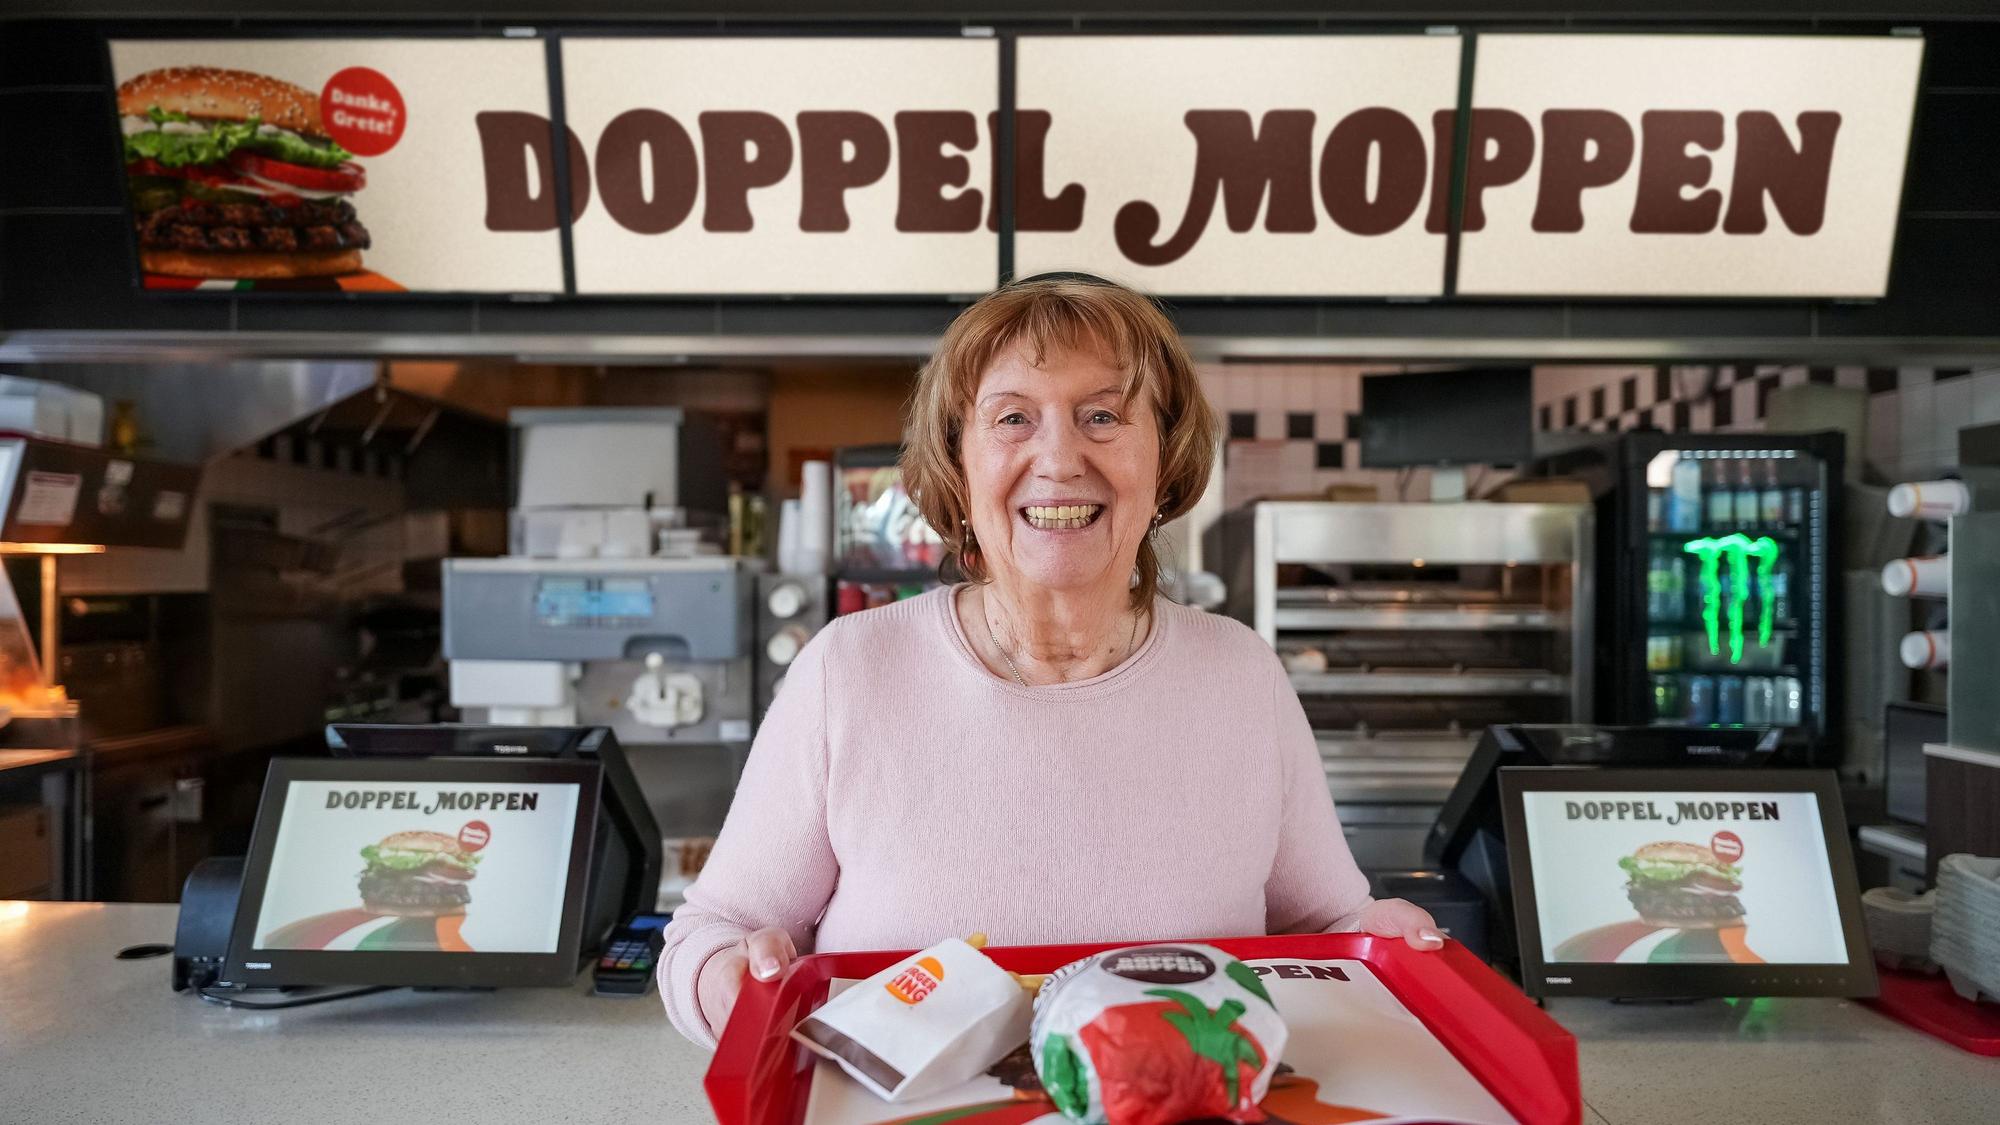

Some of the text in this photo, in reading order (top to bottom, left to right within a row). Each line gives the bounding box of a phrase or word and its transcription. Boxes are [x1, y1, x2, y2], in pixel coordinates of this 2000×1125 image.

[331, 88, 397, 118] Danke,
[333, 110, 394, 136] Grete!
[475, 106, 1843, 267] DOPPEL MOPPEN
[325, 790, 539, 815] DOPPEL MOPPEN
[1565, 801, 1780, 825] DOPPEL MOPPEN
[1249, 965, 1351, 981] PEN
